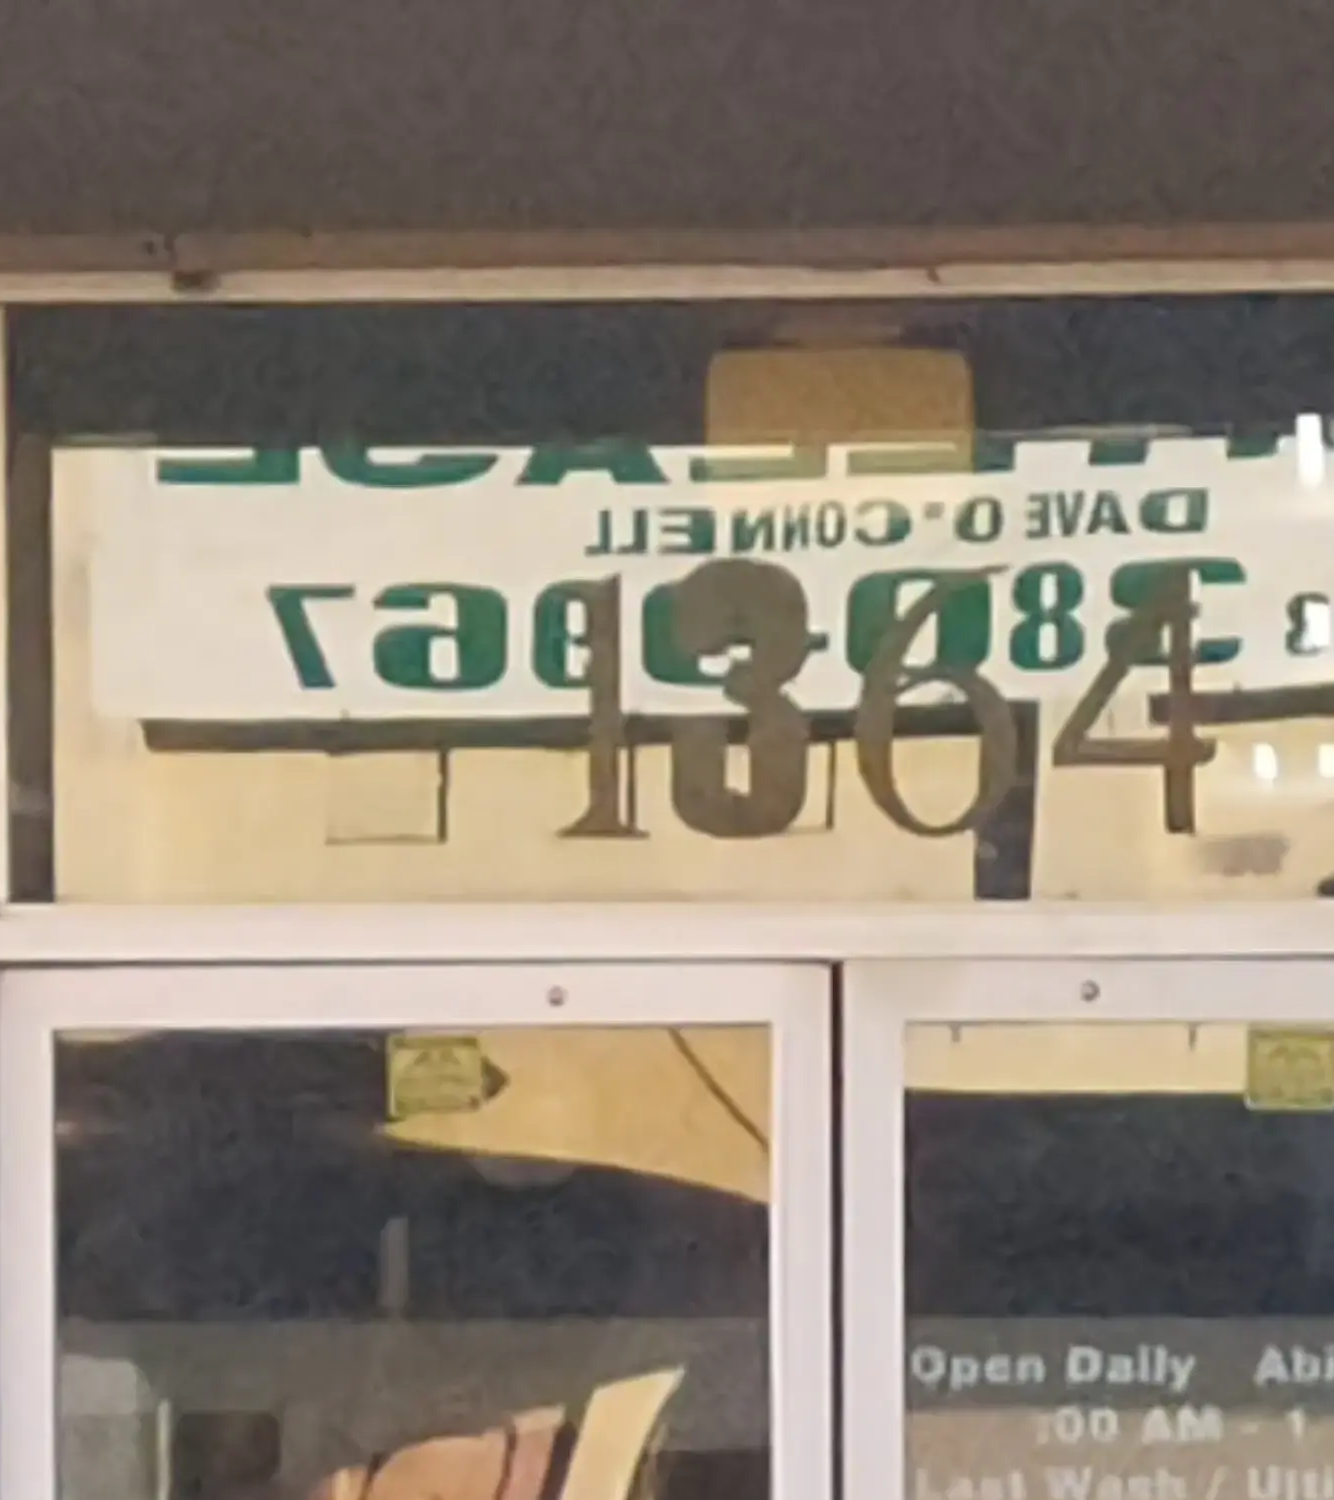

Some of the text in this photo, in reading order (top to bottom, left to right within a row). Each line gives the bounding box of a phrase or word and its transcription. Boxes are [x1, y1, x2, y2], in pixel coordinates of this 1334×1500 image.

[556, 556, 1217, 839] 1364
[910, 1344, 1046, 1391] Open
[1065, 1342, 1196, 1392] Daily
[1141, 1403, 1225, 1445] AM
